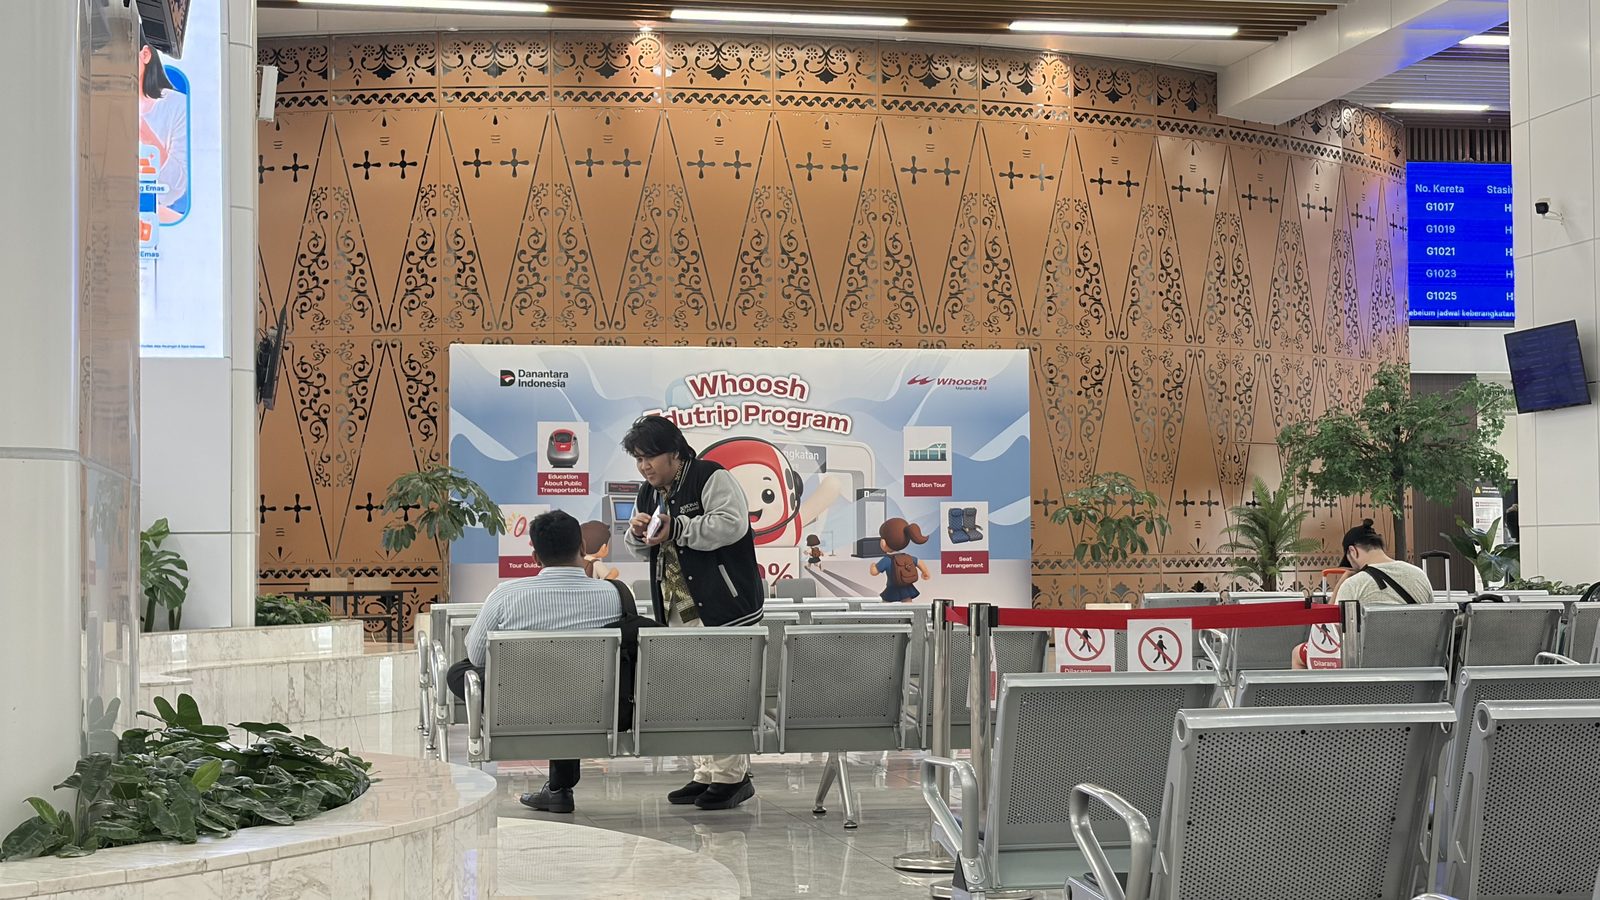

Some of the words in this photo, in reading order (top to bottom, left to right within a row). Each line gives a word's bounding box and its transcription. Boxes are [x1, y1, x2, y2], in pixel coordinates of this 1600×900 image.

[145, 184, 165, 192] Emas
[1415, 184, 1431, 193] No.
[1433, 184, 1465, 193] Kereta
[1425, 202, 1455, 211] G1017
[1426, 224, 1455, 233] G1019
[1426, 247, 1455, 256] G1021
[1425, 269, 1457, 278] G1023
[1426, 291, 1457, 300] G1025
[1437, 309, 1460, 318] jadwal
[518, 369, 569, 378] Danantara
[518, 379, 566, 388] Indonesia
[937, 377, 987, 386] Whoosh
[689, 374, 806, 399] Whoosh
[648, 404, 739, 427] dutrip
[744, 404, 849, 433] Program
[1313, 660, 1338, 669] Dilarang
